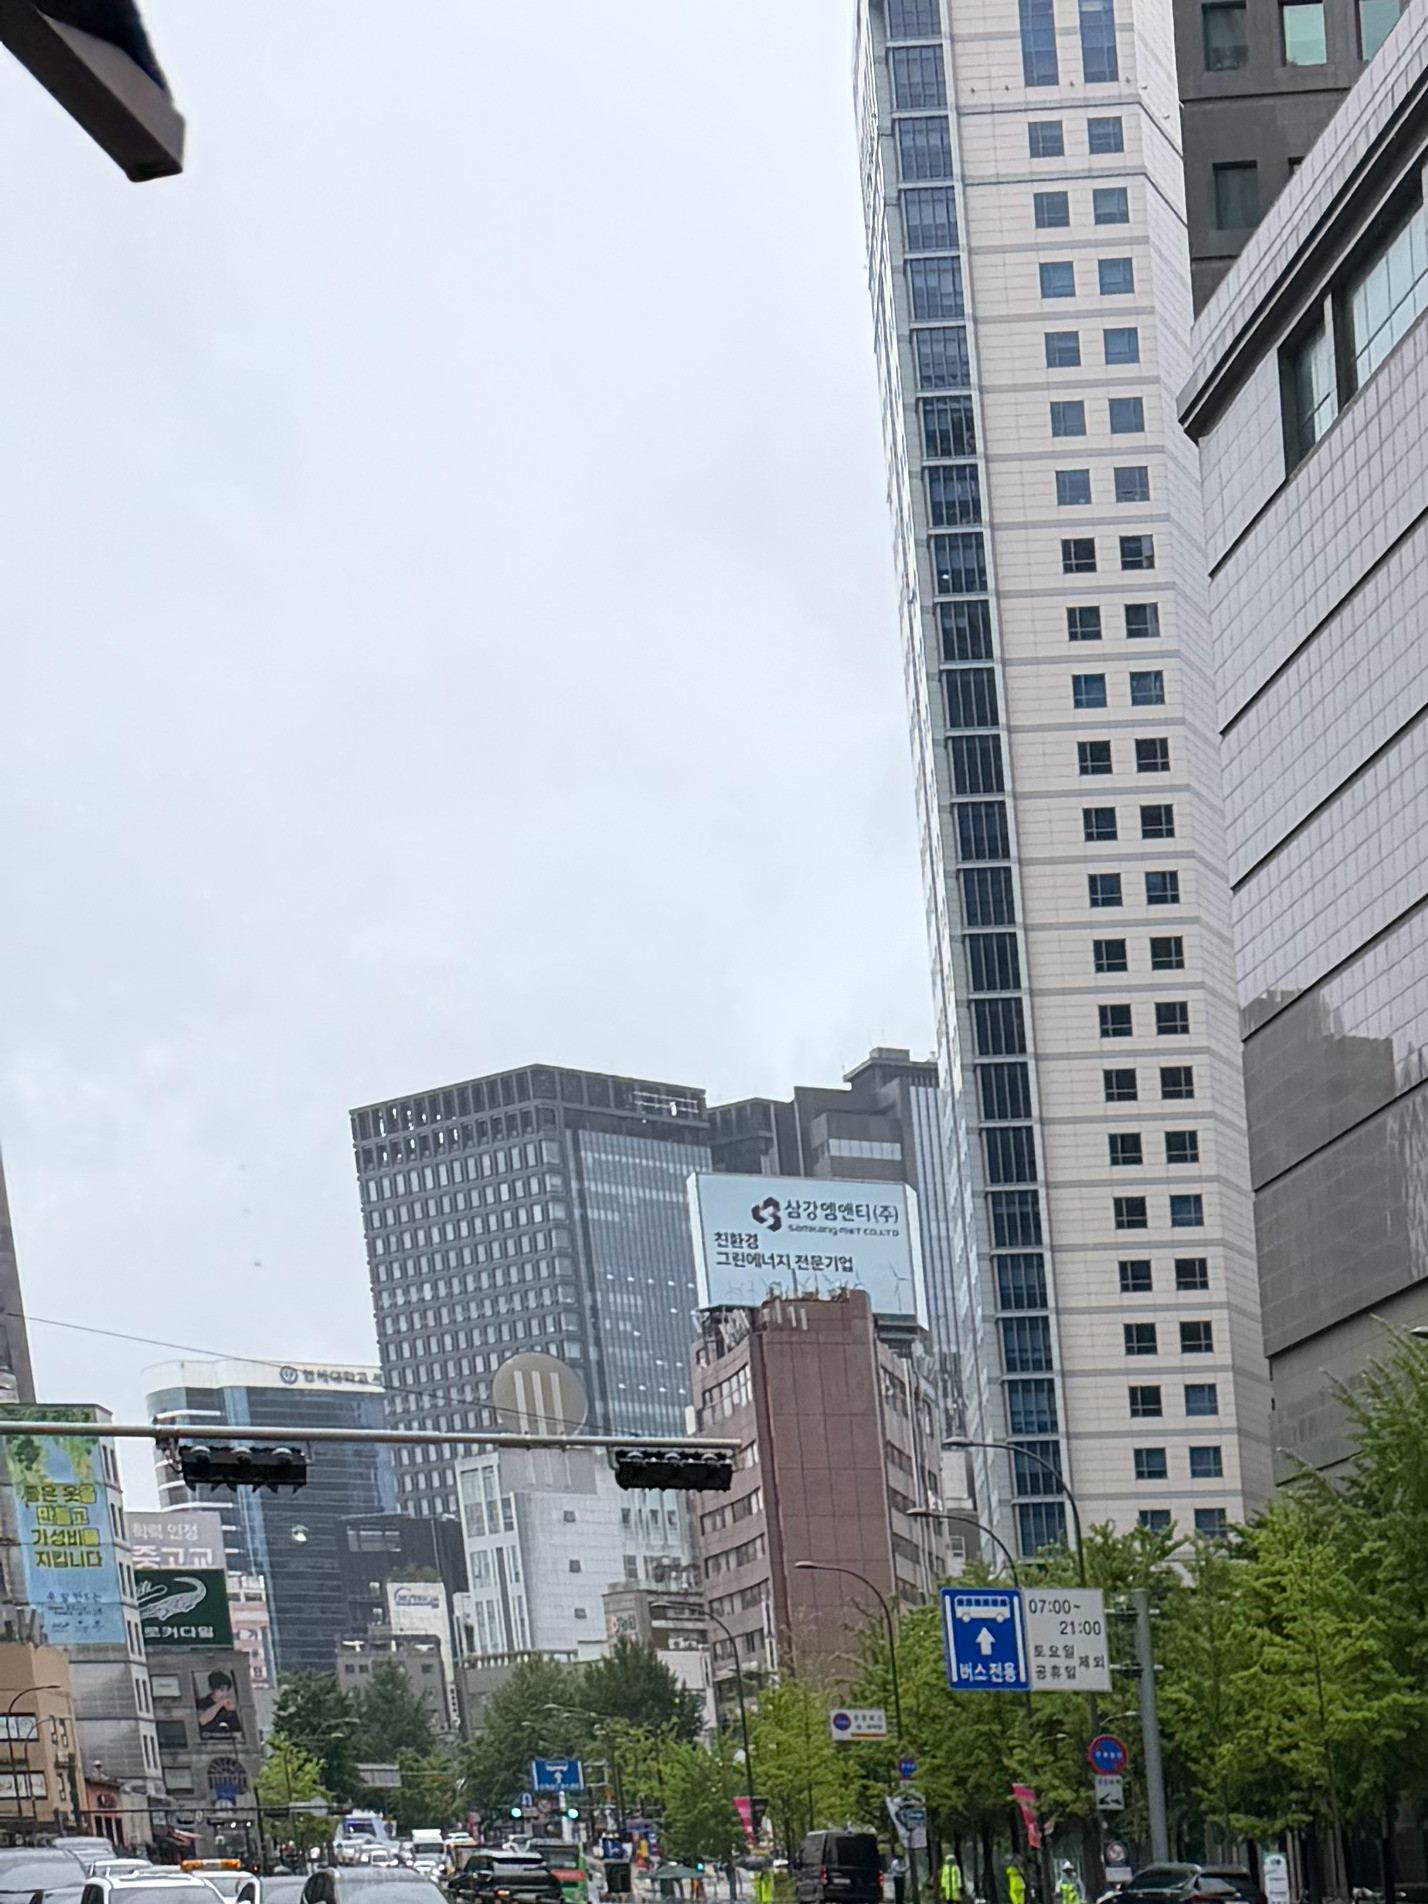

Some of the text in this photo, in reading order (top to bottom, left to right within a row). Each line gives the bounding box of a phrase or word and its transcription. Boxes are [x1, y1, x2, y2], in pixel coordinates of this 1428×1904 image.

[713, 1231, 759, 1250] 친환경
[715, 1251, 854, 1273] 그린에너지 전문기업
[1028, 1599, 1081, 1615] 07:00~
[1059, 1620, 1102, 1636] 21:00
[1033, 1644, 1076, 1659] 토요일
[1078, 1654, 1105, 1670] 제외
[959, 1661, 1017, 1684] 버스전용
[1035, 1664, 1077, 1680] 공휴일
